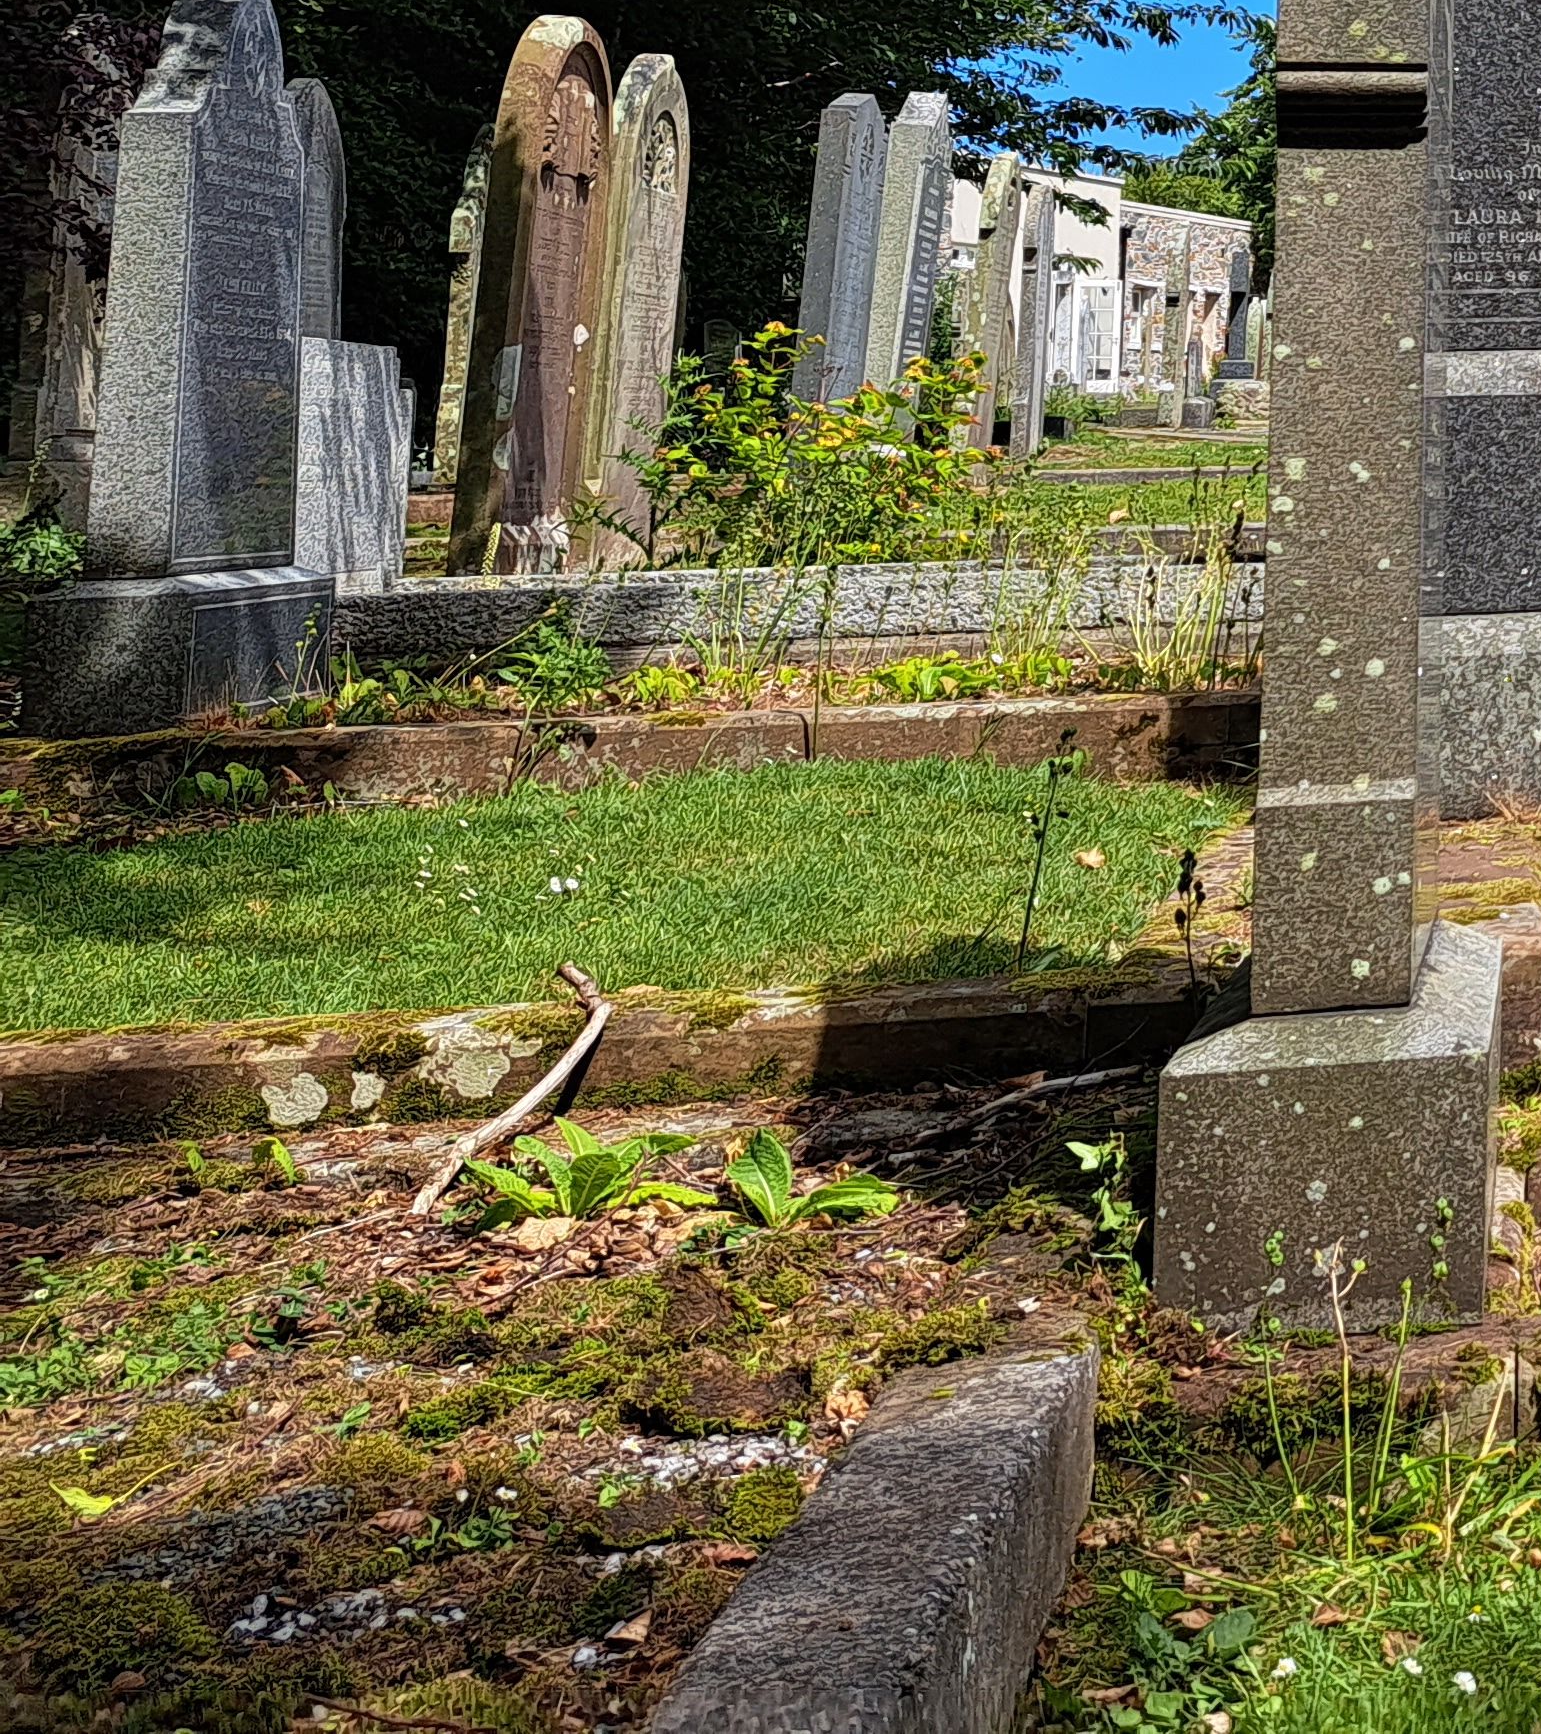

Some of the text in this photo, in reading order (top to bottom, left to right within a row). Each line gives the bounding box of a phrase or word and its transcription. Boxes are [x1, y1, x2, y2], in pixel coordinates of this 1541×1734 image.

[1449, 165, 1513, 185] Loving
[1454, 209, 1524, 225] LAURA
[1447, 231, 1472, 244] IFE
[1451, 270, 1494, 283] AGED
[1505, 270, 1530, 282] 96
